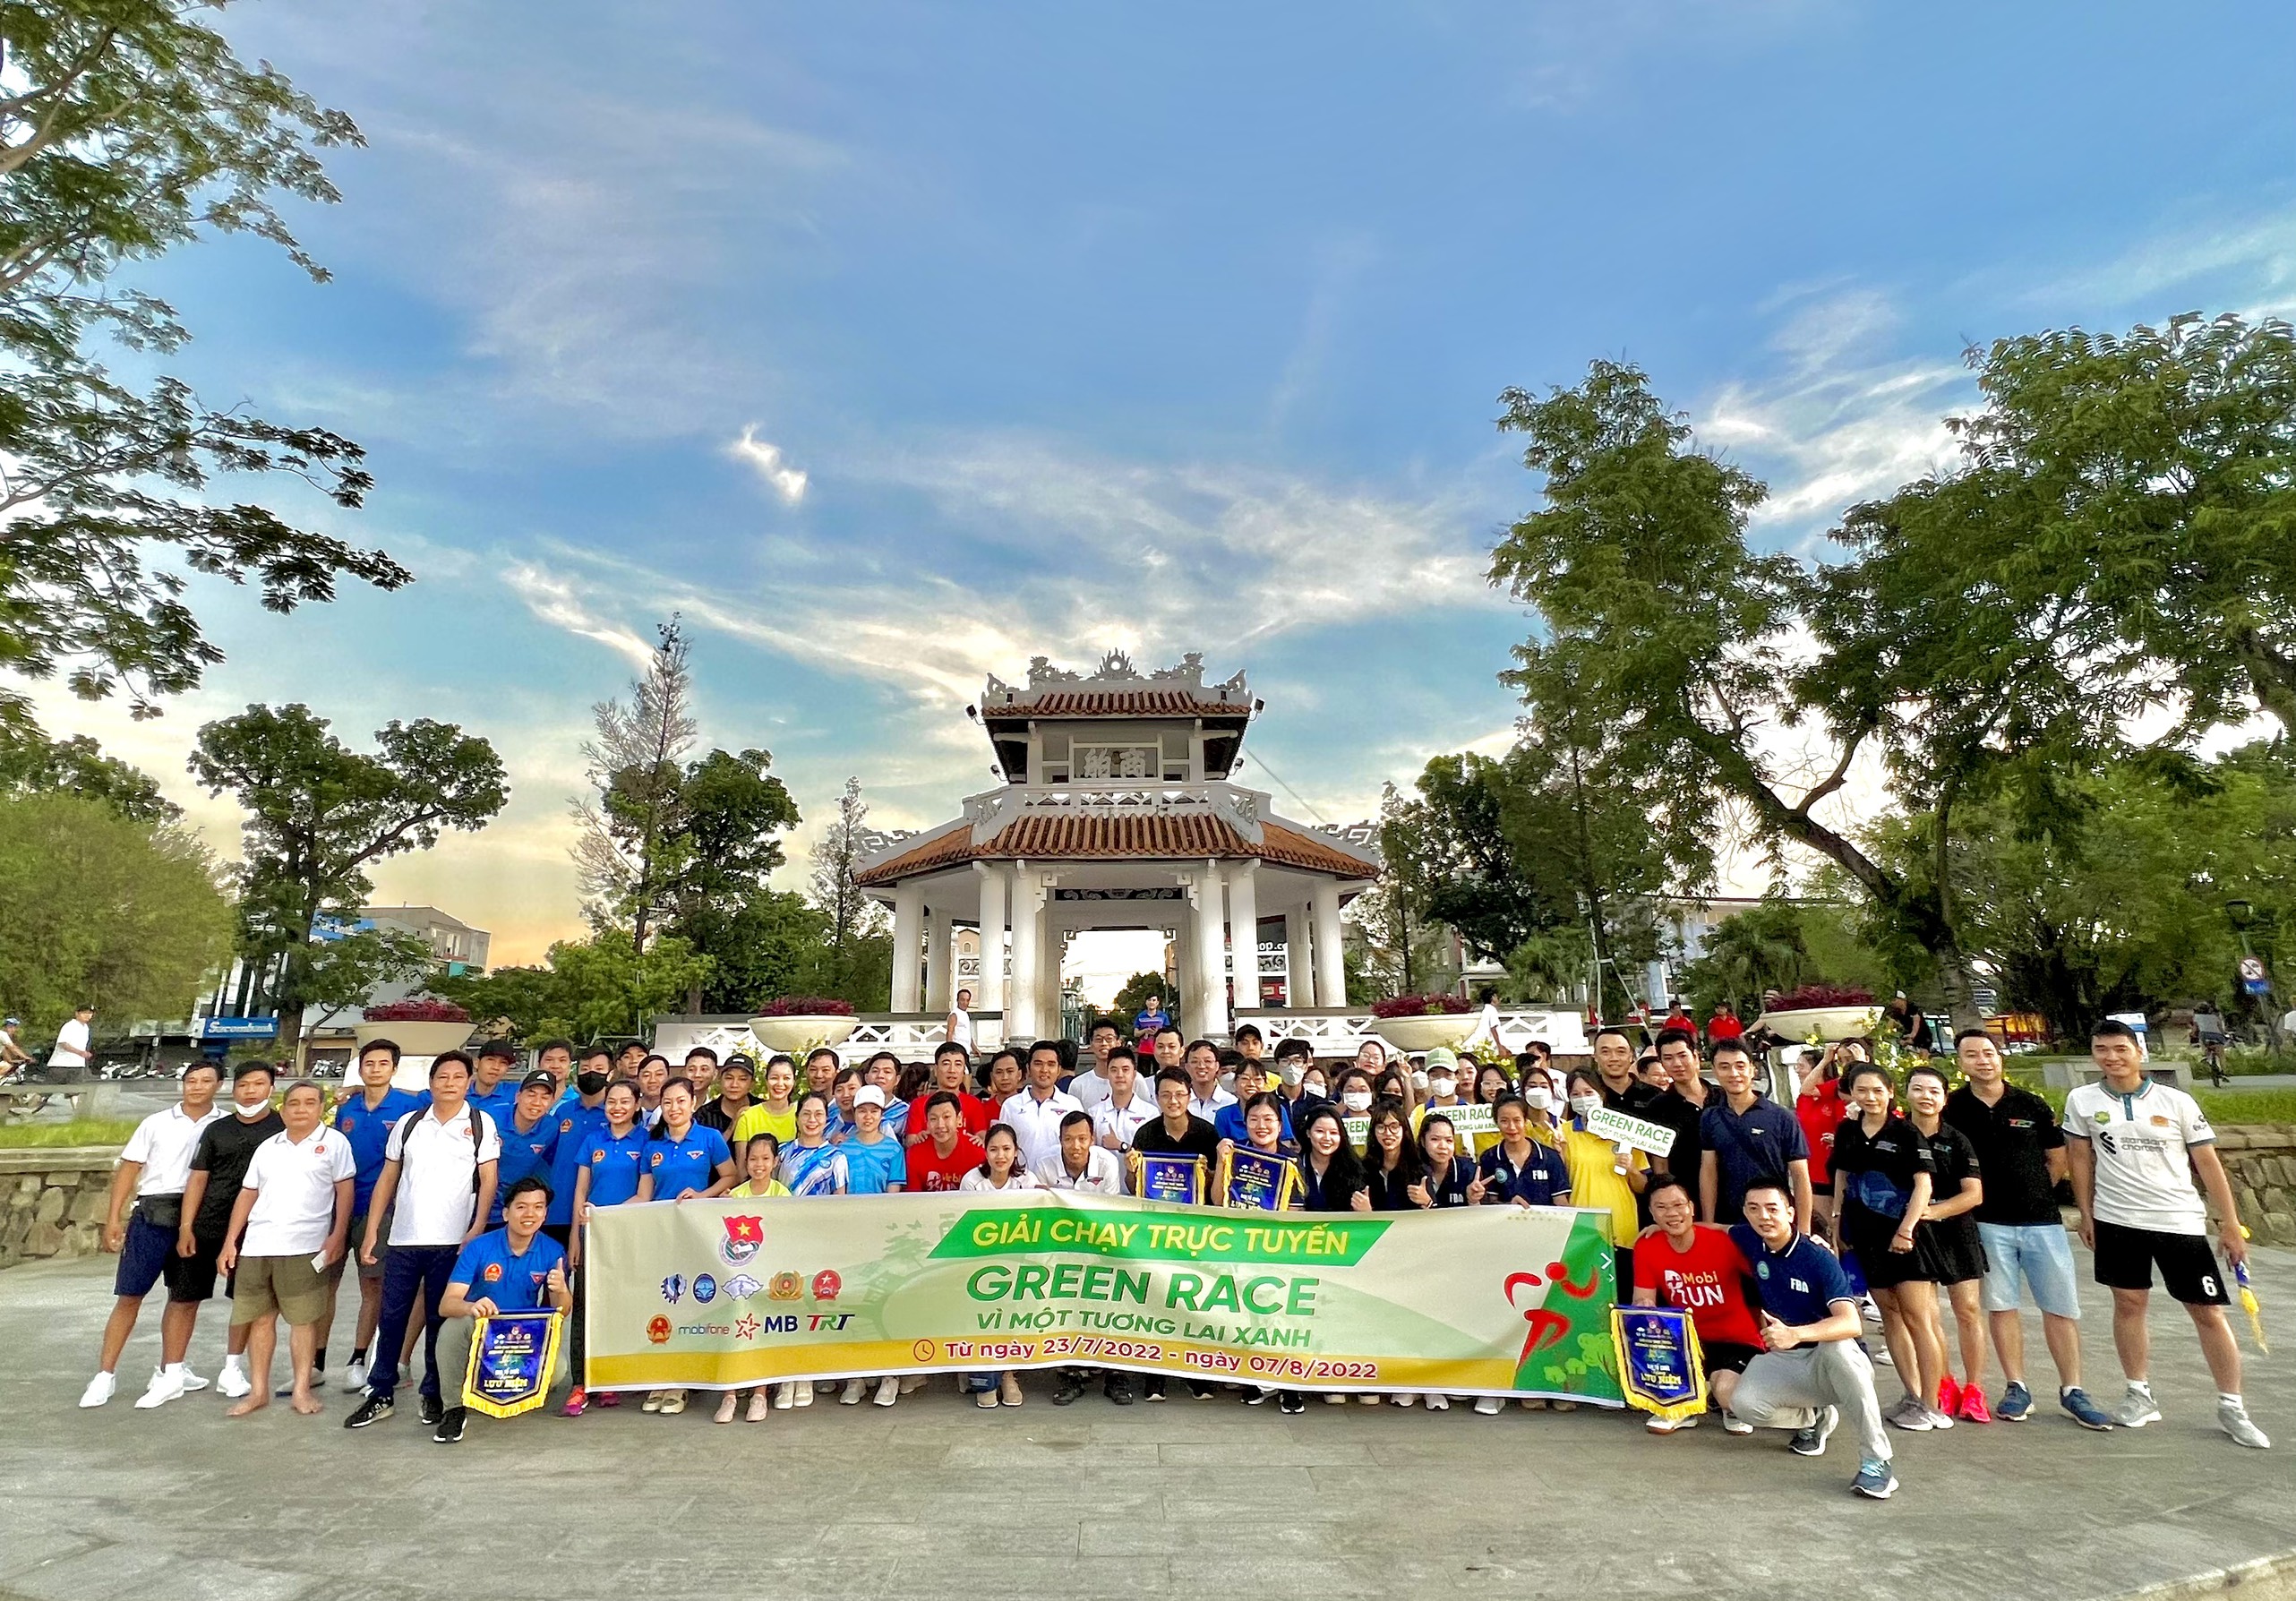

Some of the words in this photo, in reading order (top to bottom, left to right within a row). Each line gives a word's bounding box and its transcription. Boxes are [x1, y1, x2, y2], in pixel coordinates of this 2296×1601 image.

[1590, 1109, 1634, 1132] GREEN
[1634, 1123, 1672, 1144] RACE
[972, 1213, 1042, 1246] GIẢI
[1049, 1219, 1139, 1252] CHẠY
[1147, 1223, 1235, 1257] TRỰC
[1244, 1221, 1349, 1255] TUYẾN
[1682, 1271, 1719, 1285] Mobi
[1790, 1278, 1810, 1294] FBA
[2202, 1275, 2218, 1297] 6
[966, 1263, 1152, 1305] GREEN
[1165, 1273, 1321, 1317] RACE
[678, 1323, 730, 1335] mobifone
[764, 1315, 799, 1334] MB
[807, 1314, 856, 1331] TRT
[977, 1307, 1003, 1330] VÌ
[1009, 1307, 1073, 1333] MỘT
[1079, 1310, 1177, 1335] TƯƠNG
[1183, 1321, 1226, 1342] LAI
[1232, 1326, 1312, 1348] XANH
[945, 1340, 973, 1357] Từ
[980, 1342, 1034, 1359] ngày
[1043, 1335, 1162, 1360] 23/7/2022
[1185, 1350, 1241, 1371] ngày
[1249, 1356, 1378, 1380] 07/8/2022
